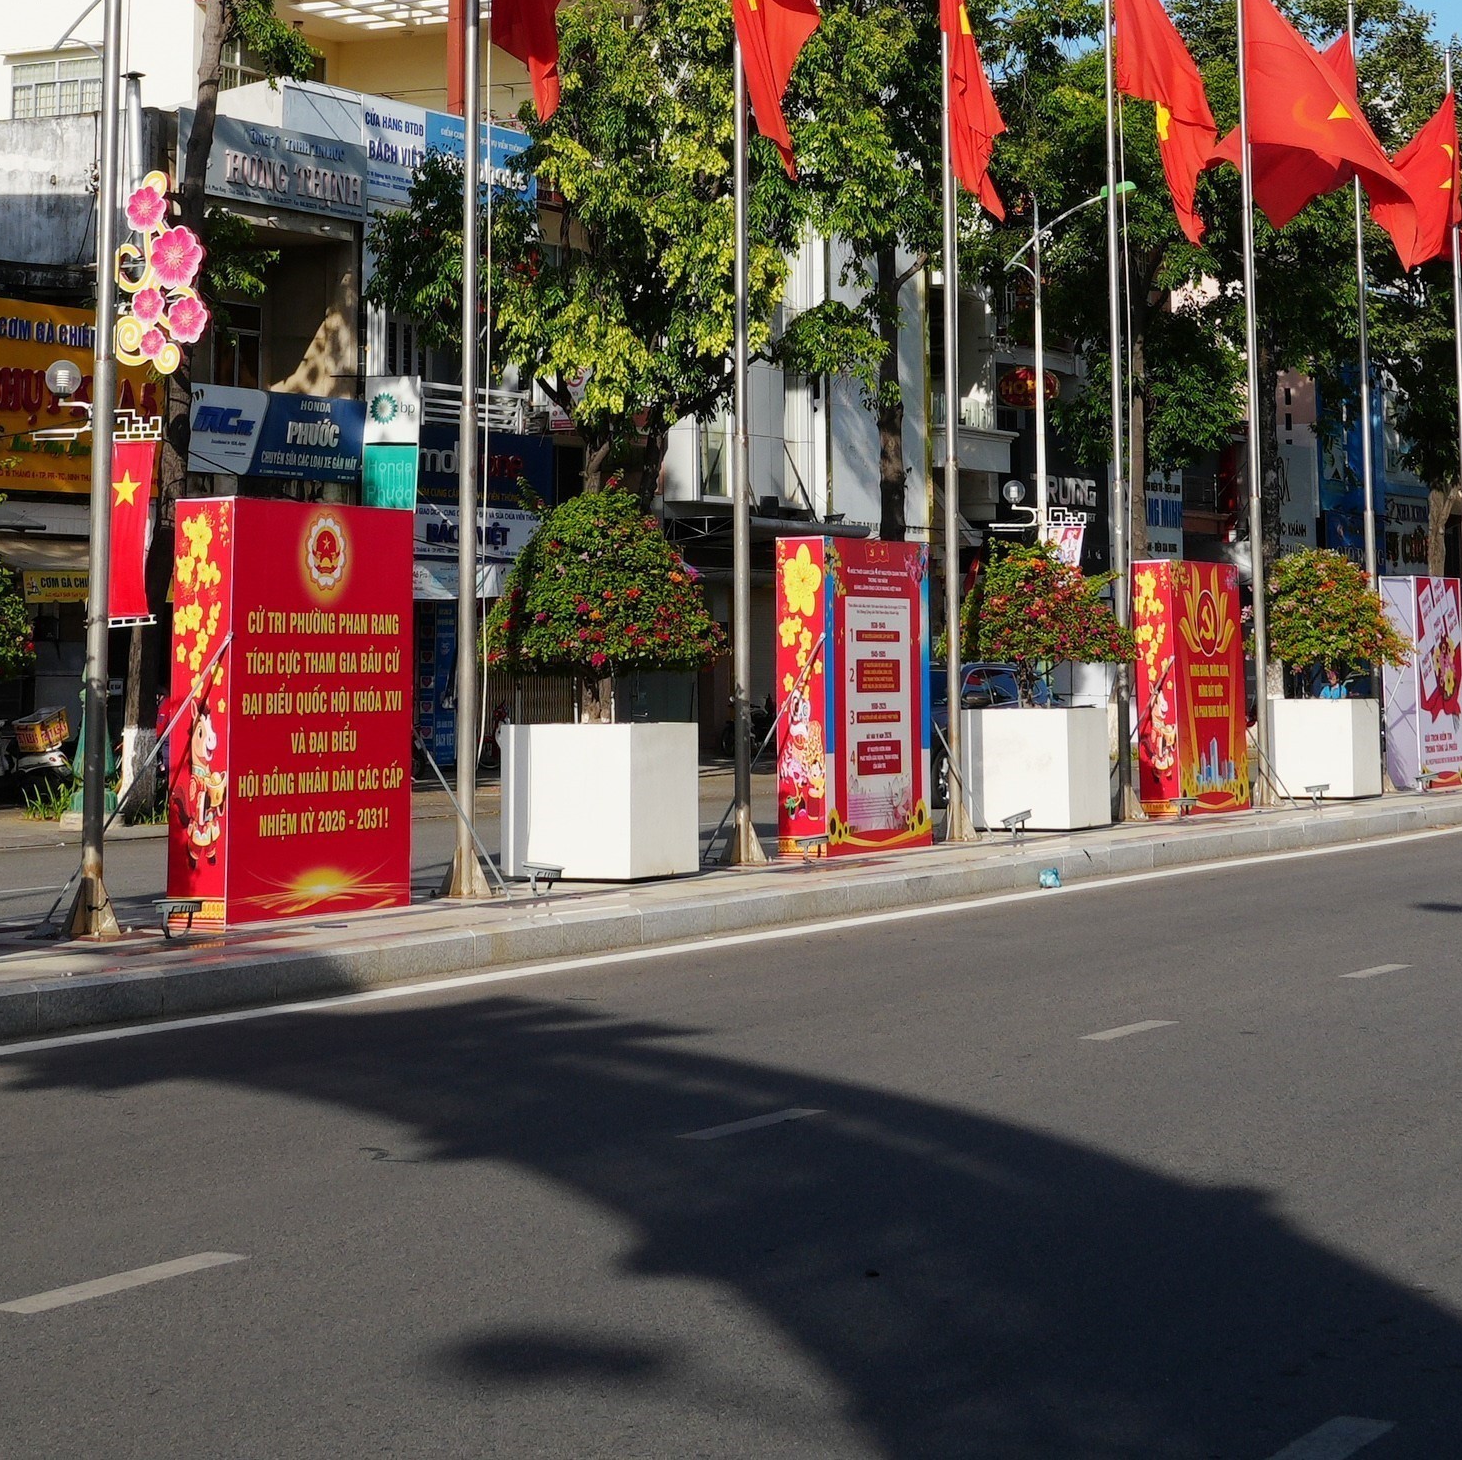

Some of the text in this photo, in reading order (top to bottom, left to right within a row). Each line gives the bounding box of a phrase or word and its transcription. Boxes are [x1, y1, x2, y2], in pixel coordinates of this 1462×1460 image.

[365, 108, 380, 127] CỬA
[382, 113, 402, 133] HÀNG
[367, 138, 398, 164] BÁCH
[225, 149, 289, 194] HƯNG
[294, 164, 363, 207] THỊNH
[34, 317, 55, 344] GÀ
[300, 400, 331, 413] HONDA
[400, 402, 415, 416] bp
[286, 418, 340, 448] PHƯỚC
[297, 451, 310, 467] CÁC
[367, 459, 413, 474] Honda
[248, 606, 399, 635] CỬ TRI PHƯỜNG PHAN RANG
[246, 645, 400, 679] TÍCH CỰC THAM GIA BẦU CỬ
[242, 683, 402, 718] ĐẠI BIỂU QUỐC HỘI KHÓA XVI
[291, 721, 357, 757] VÀ ĐẠI BIỂU
[238, 759, 403, 802] HỘI ĐỒNG NHÂN DÂN CÁC CẤP
[259, 806, 388, 840] NHIỆM KỲ 2026 2031!
